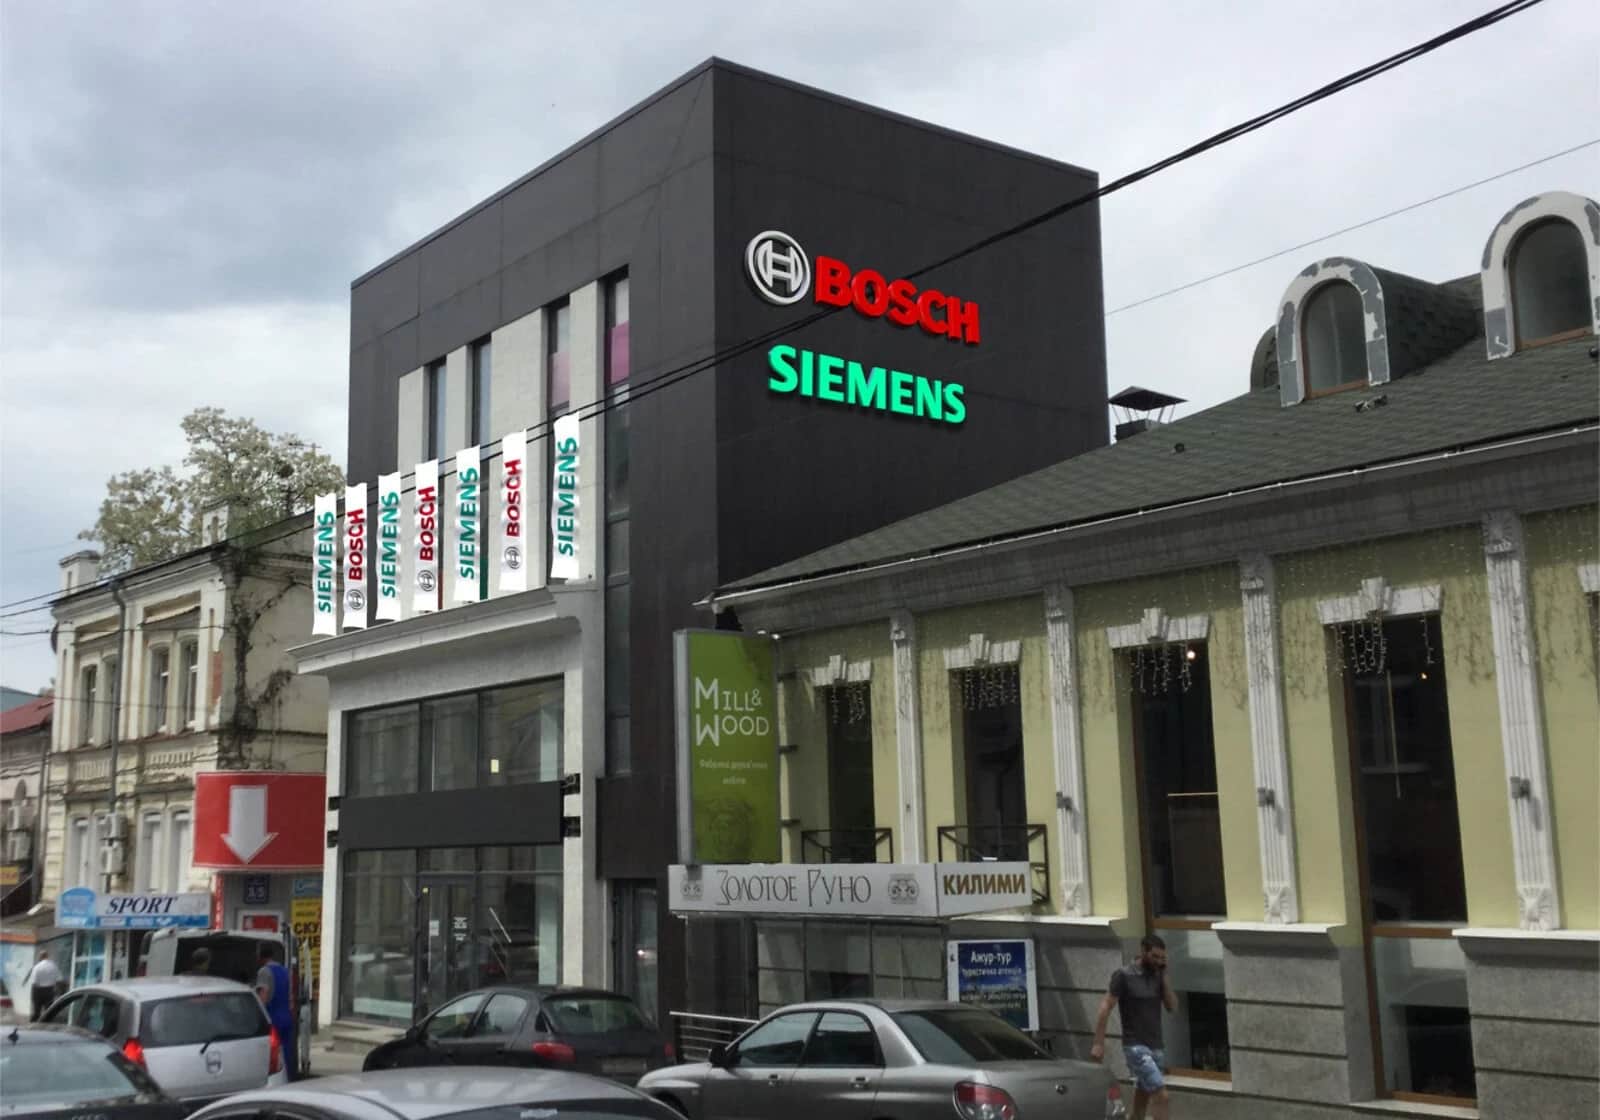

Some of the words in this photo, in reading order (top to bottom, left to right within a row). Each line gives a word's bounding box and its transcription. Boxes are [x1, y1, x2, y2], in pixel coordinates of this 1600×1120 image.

[814, 255, 981, 344] BOSCH
[767, 344, 967, 424] SIEMENS
[418, 485, 436, 561] BOSCH
[459, 467, 478, 580] SIEMENS
[504, 459, 521, 537] BOSCH
[558, 437, 577, 556] SIEMENS
[317, 511, 336, 613] SIEMENS
[347, 508, 365, 581] BOSCH
[381, 490, 400, 598] SIEMENS
[106, 896, 178, 914] SPORT
[807, 869, 872, 907] РУНО
[943, 873, 1026, 896] КИЛИМИ
[970, 951, 1012, 965] Ажур-тур
